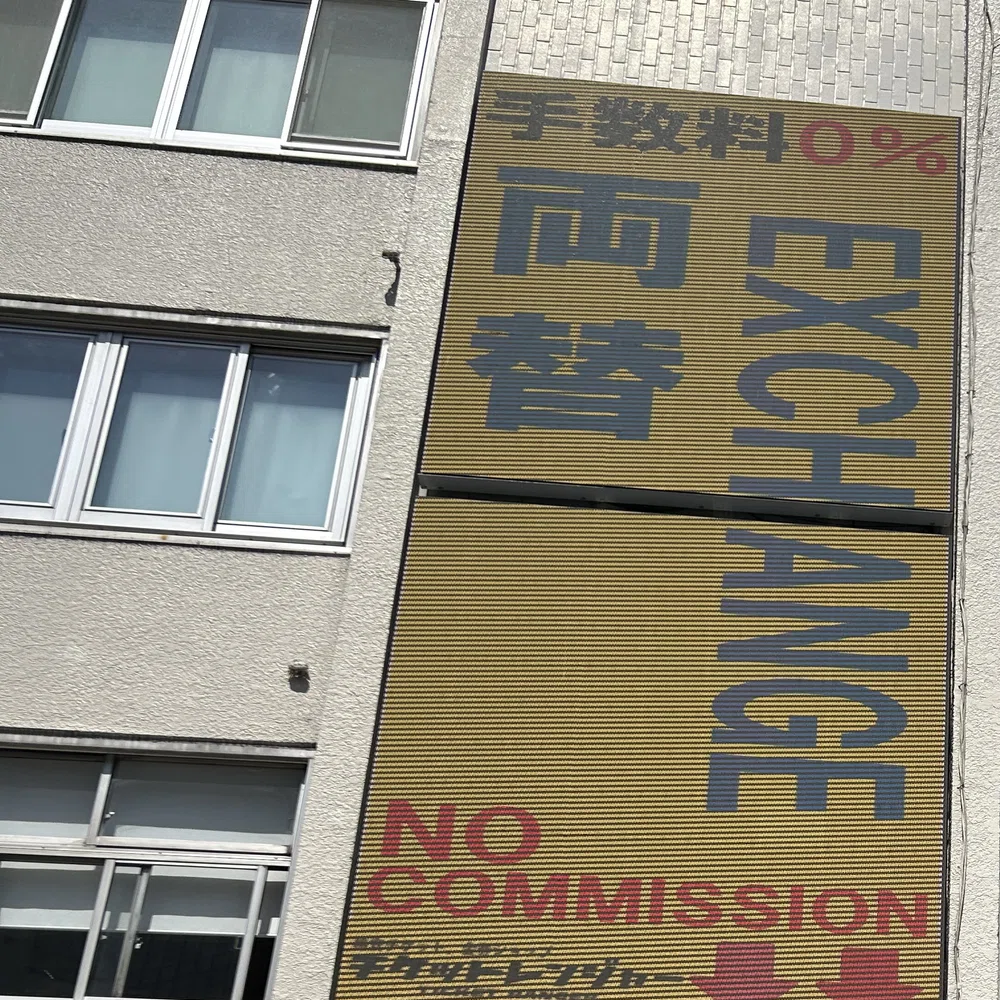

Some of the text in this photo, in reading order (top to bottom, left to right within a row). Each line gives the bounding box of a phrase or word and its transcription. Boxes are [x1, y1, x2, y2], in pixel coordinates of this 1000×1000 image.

[467, 166, 701, 441] 両替
[706, 215, 922, 820] EXCHANGE
[366, 866, 930, 939] COMMISSION
[380, 799, 542, 865] NO
